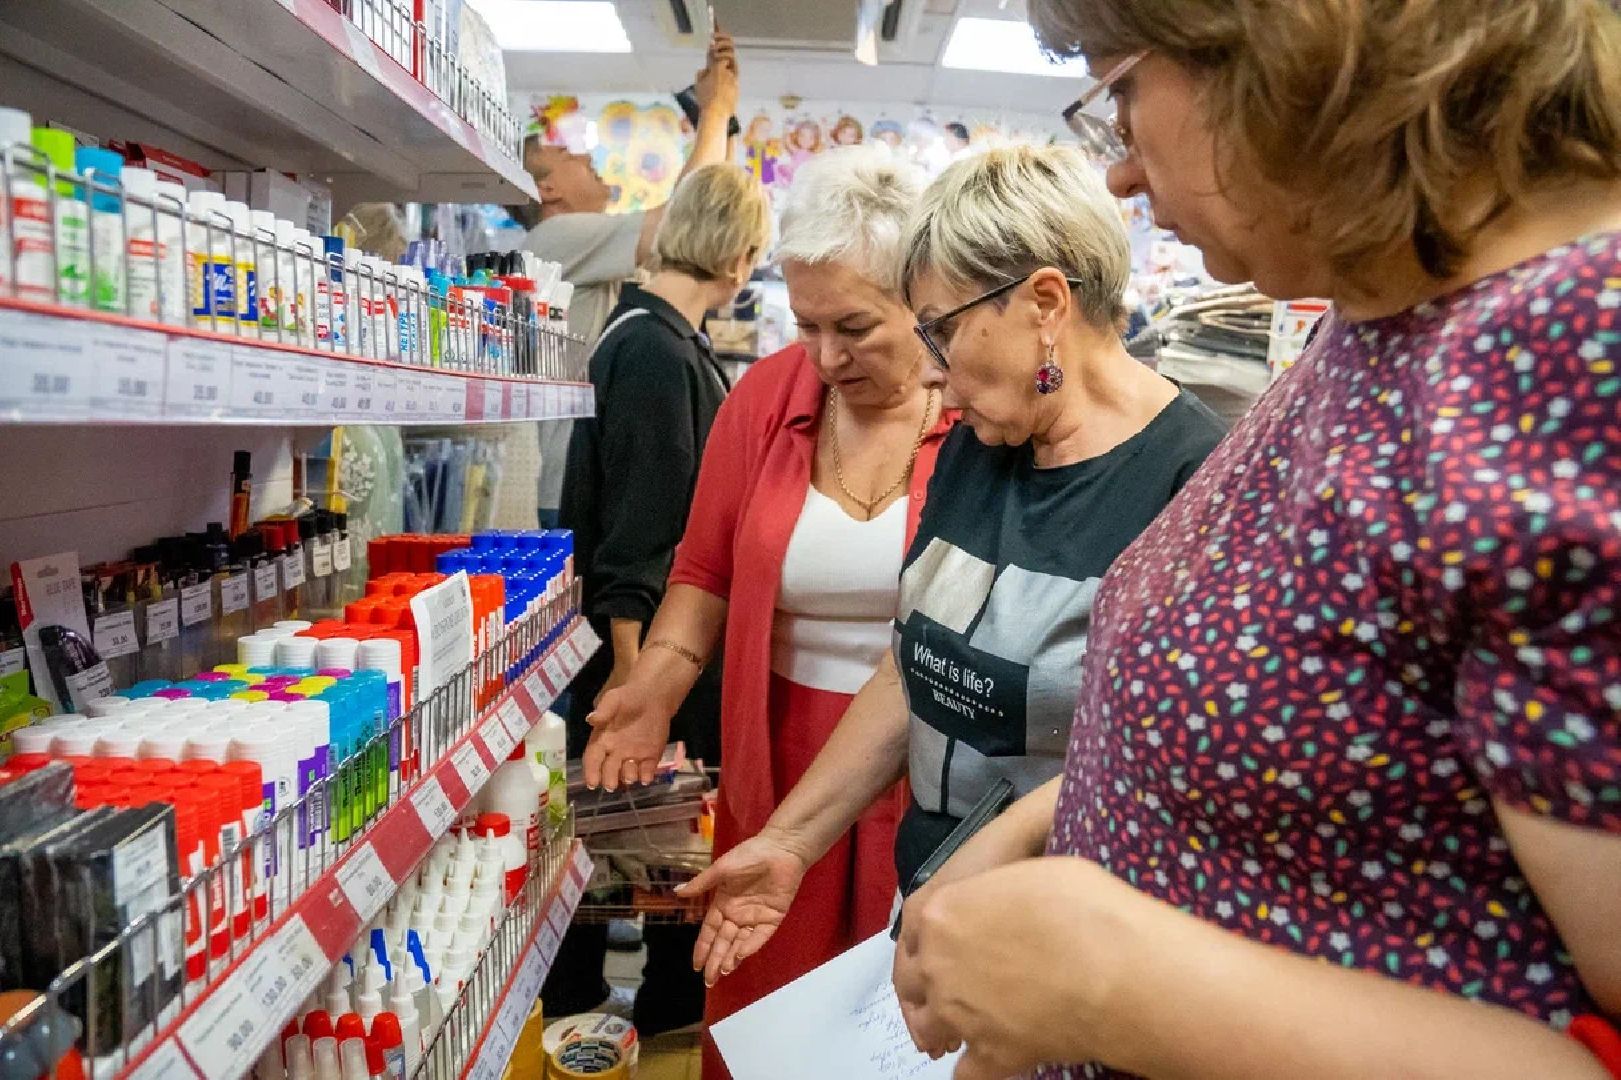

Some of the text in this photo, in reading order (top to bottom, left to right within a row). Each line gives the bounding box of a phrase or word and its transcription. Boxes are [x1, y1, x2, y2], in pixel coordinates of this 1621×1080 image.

[914, 641, 994, 698] What is life?
[932, 688, 975, 720] BEAUTY
